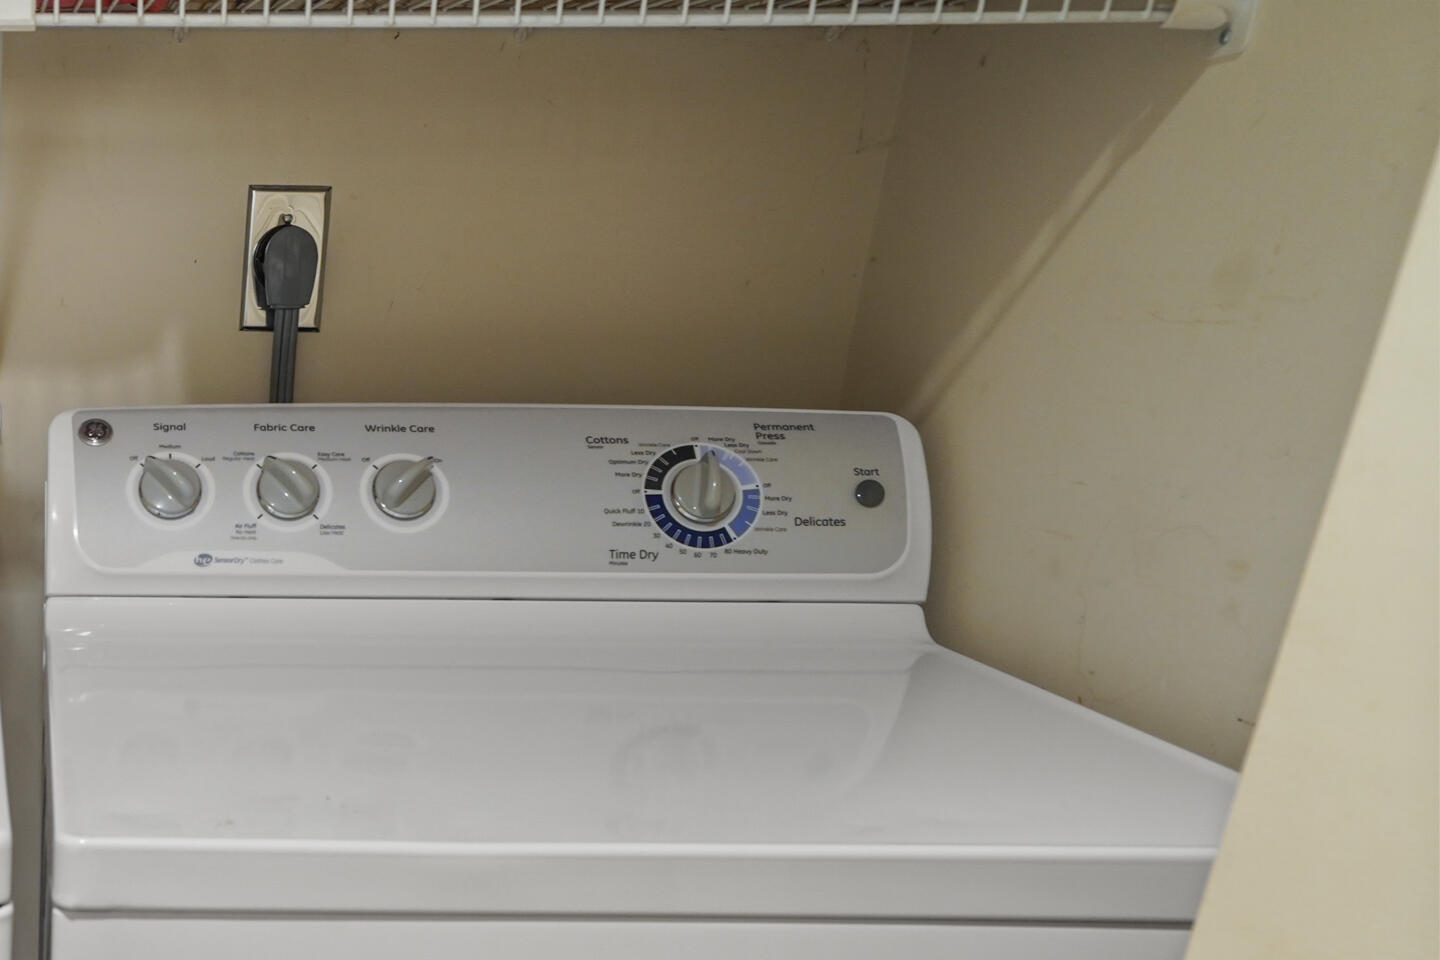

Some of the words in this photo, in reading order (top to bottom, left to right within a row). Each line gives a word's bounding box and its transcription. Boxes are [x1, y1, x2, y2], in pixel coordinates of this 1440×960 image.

[153, 423, 187, 433] Signal
[253, 424, 287, 432] Fabric
[289, 424, 316, 432] Care
[364, 424, 407, 433] Wrinkle
[409, 425, 435, 433] Care
[753, 423, 815, 432] Permanent
[585, 435, 629, 445] Cottons
[755, 432, 786, 441] Press
[853, 467, 880, 476] Start
[794, 516, 847, 527] Delicates
[609, 549, 637, 560] Time
[639, 549, 659, 562] Dry
